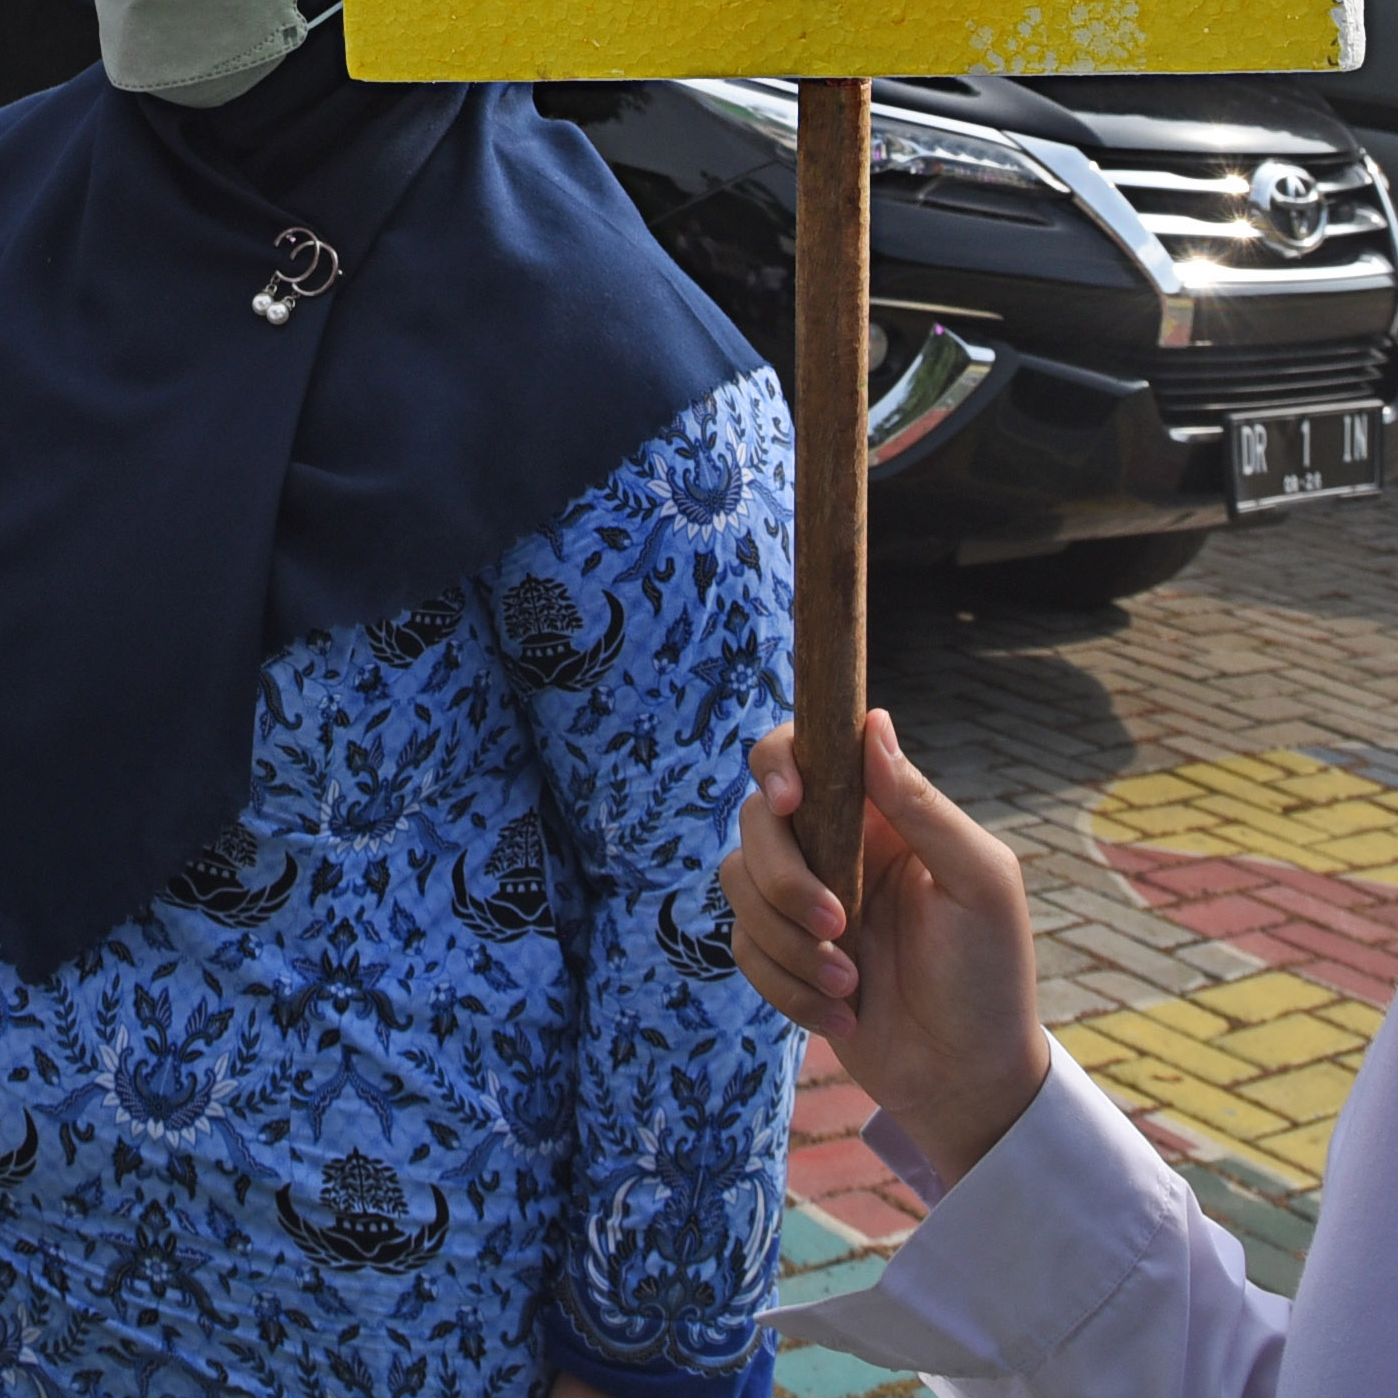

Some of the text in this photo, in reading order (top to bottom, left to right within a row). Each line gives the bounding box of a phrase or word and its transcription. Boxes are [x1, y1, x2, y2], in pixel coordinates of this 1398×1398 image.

[1241, 413, 1368, 476] DR 1 IN
